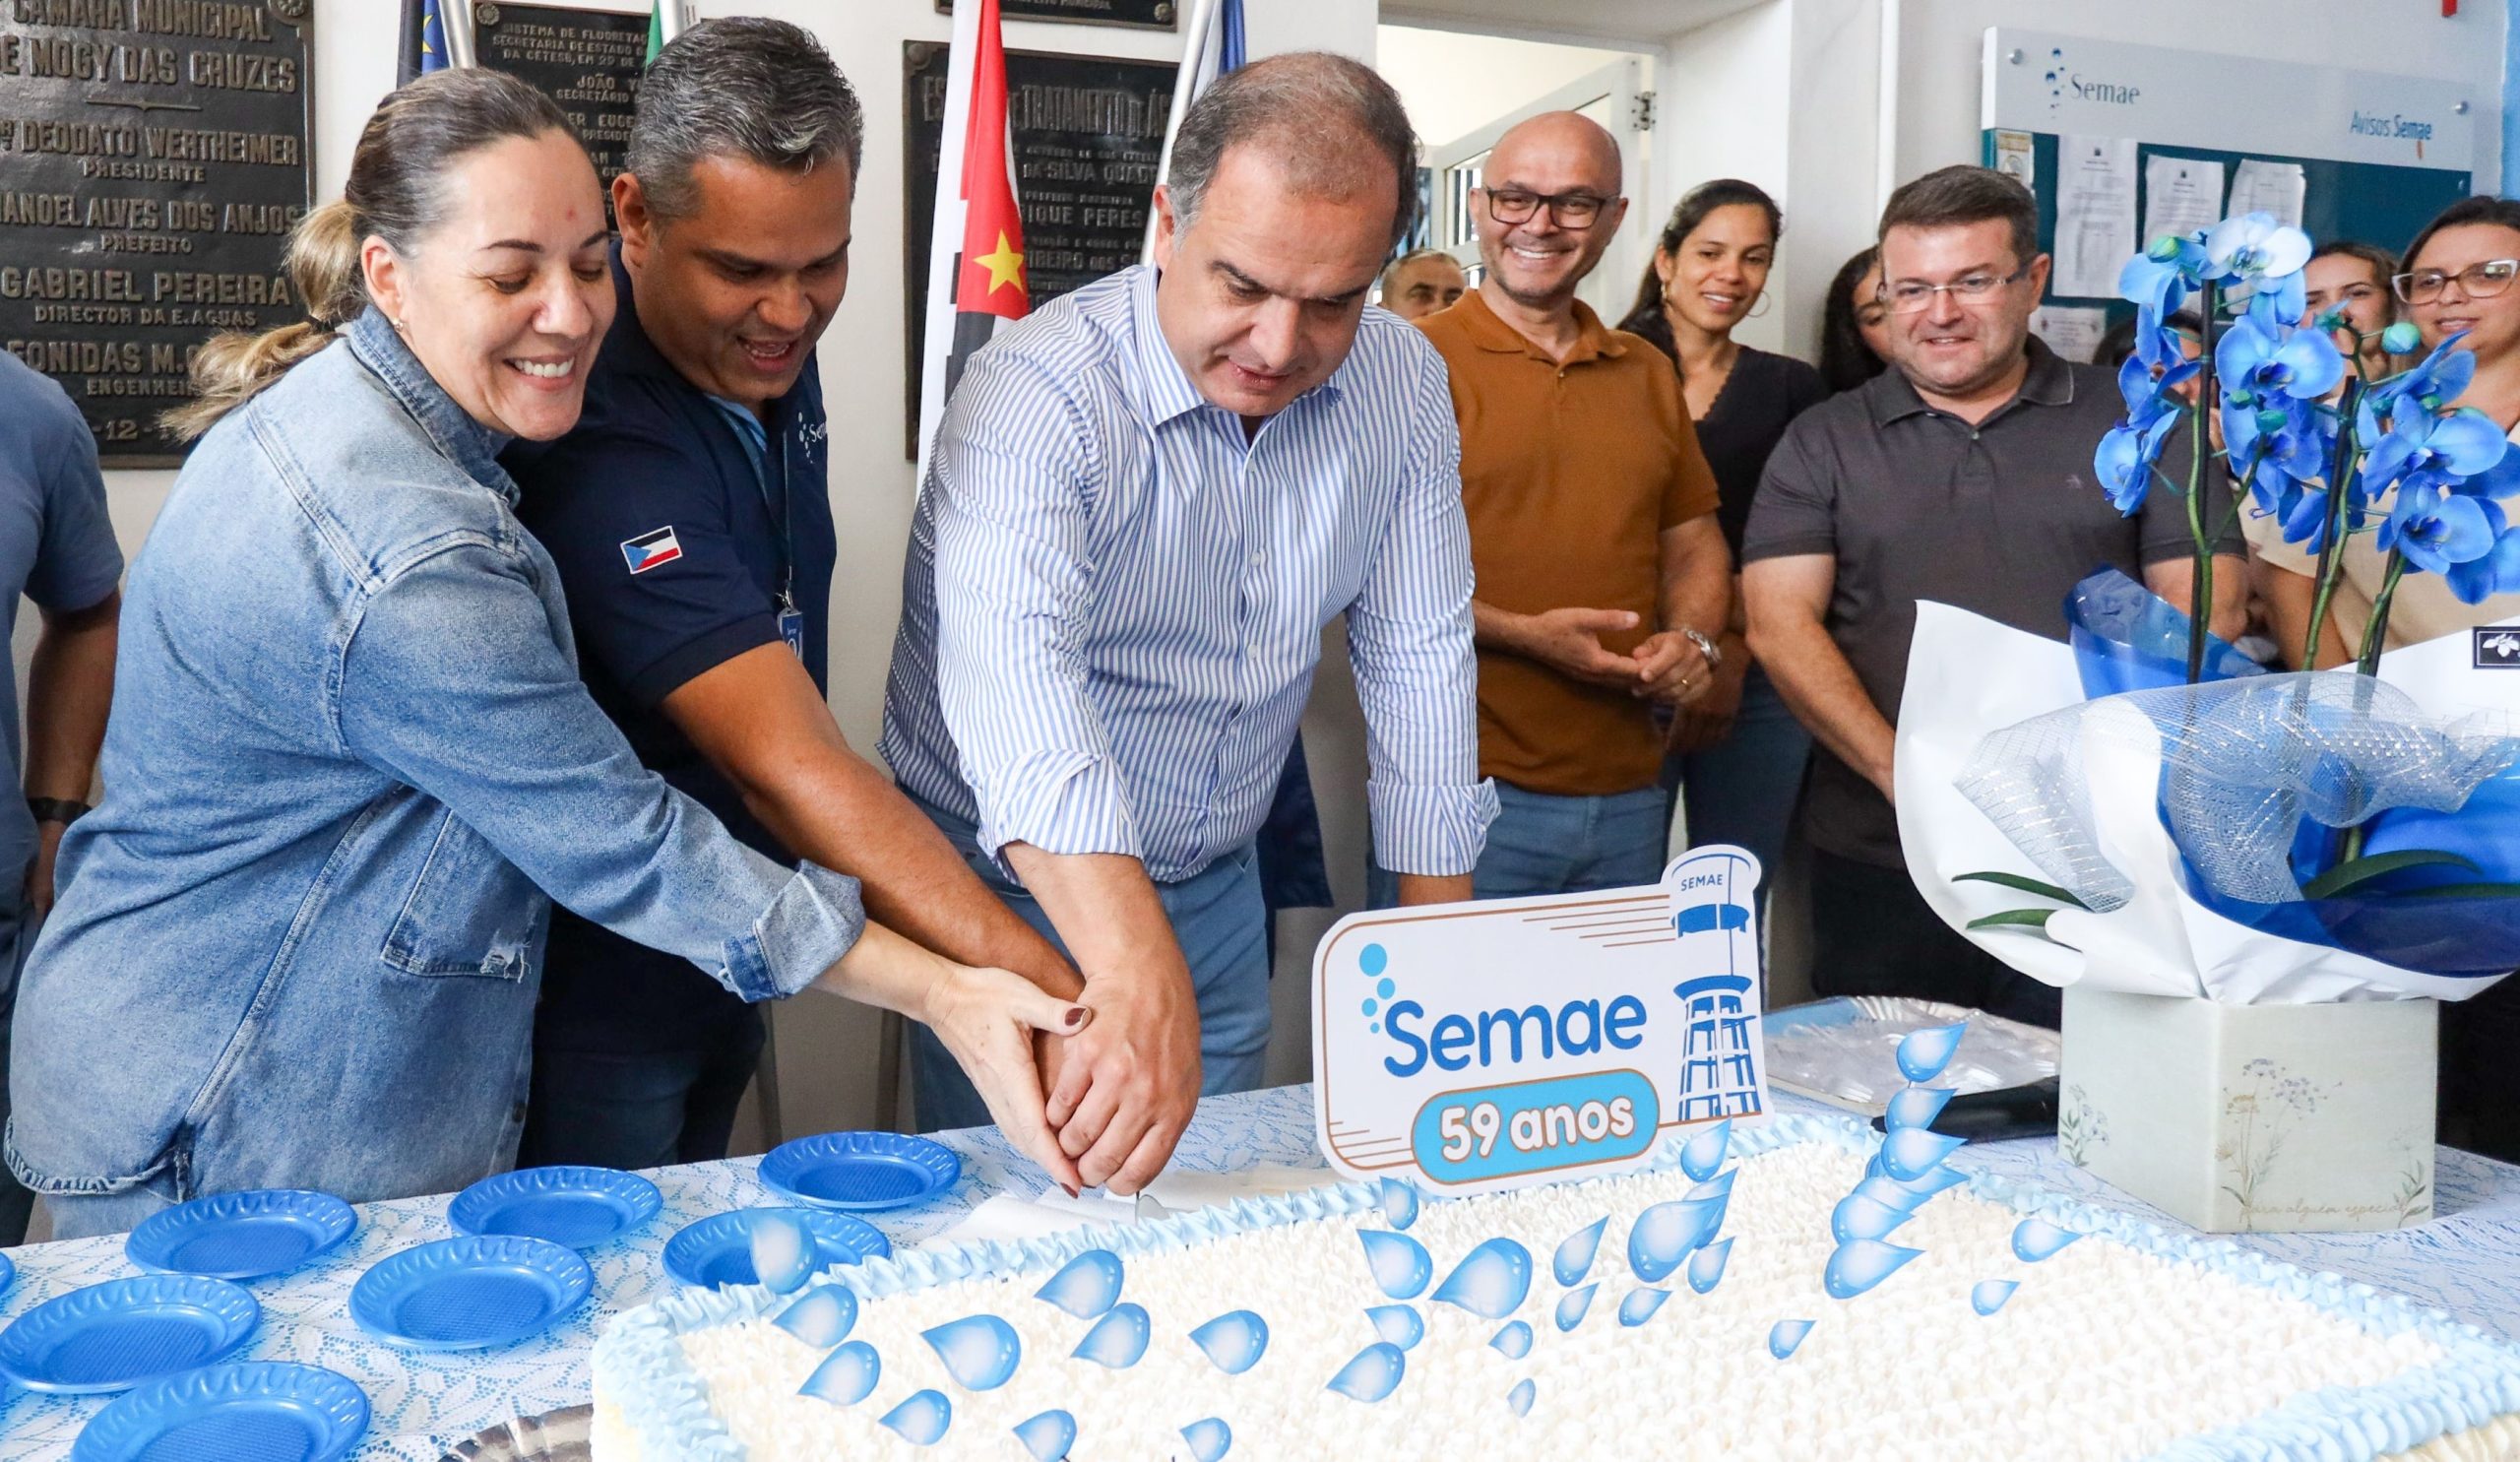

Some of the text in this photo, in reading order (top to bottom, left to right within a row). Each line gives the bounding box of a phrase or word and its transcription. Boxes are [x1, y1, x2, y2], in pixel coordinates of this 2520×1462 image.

[133, 0, 272, 43] MUNICIPAL
[502, 24, 556, 37] SISTEMA
[560, 28, 576, 38] DE
[493, 34, 565, 50] SECRETARIA
[570, 40, 584, 51] DE
[588, 42, 632, 55] ESTADO
[503, 50, 520, 59] DA
[578, 54, 596, 65] EM
[620, 57, 635, 67] DE
[30, 38, 113, 82] MOGY
[119, 45, 177, 85] DAS
[189, 50, 296, 94] CRUZES
[577, 73, 615, 90] JOÃO
[2070, 73, 2141, 104] Semae
[2349, 109, 2432, 140] Avisos Semae
[21, 120, 138, 157] DEODATO
[146, 127, 299, 166] WERTHEIMER
[83, 158, 206, 183] PRESIDENTE
[0, 190, 299, 235] ANOEL ALVES DOS ANJOS
[1084, 207, 1144, 229] PERES
[100, 233, 193, 255] PREFEITO
[1, 266, 291, 306] GABRIEL PEREIRA
[34, 304, 133, 324] DIRECTOR
[140, 307, 166, 326] DA
[1680, 873, 1724, 891] SEMAE
[1384, 994, 1648, 1078] Semae
[1439, 1096, 1636, 1163] 59 anos
